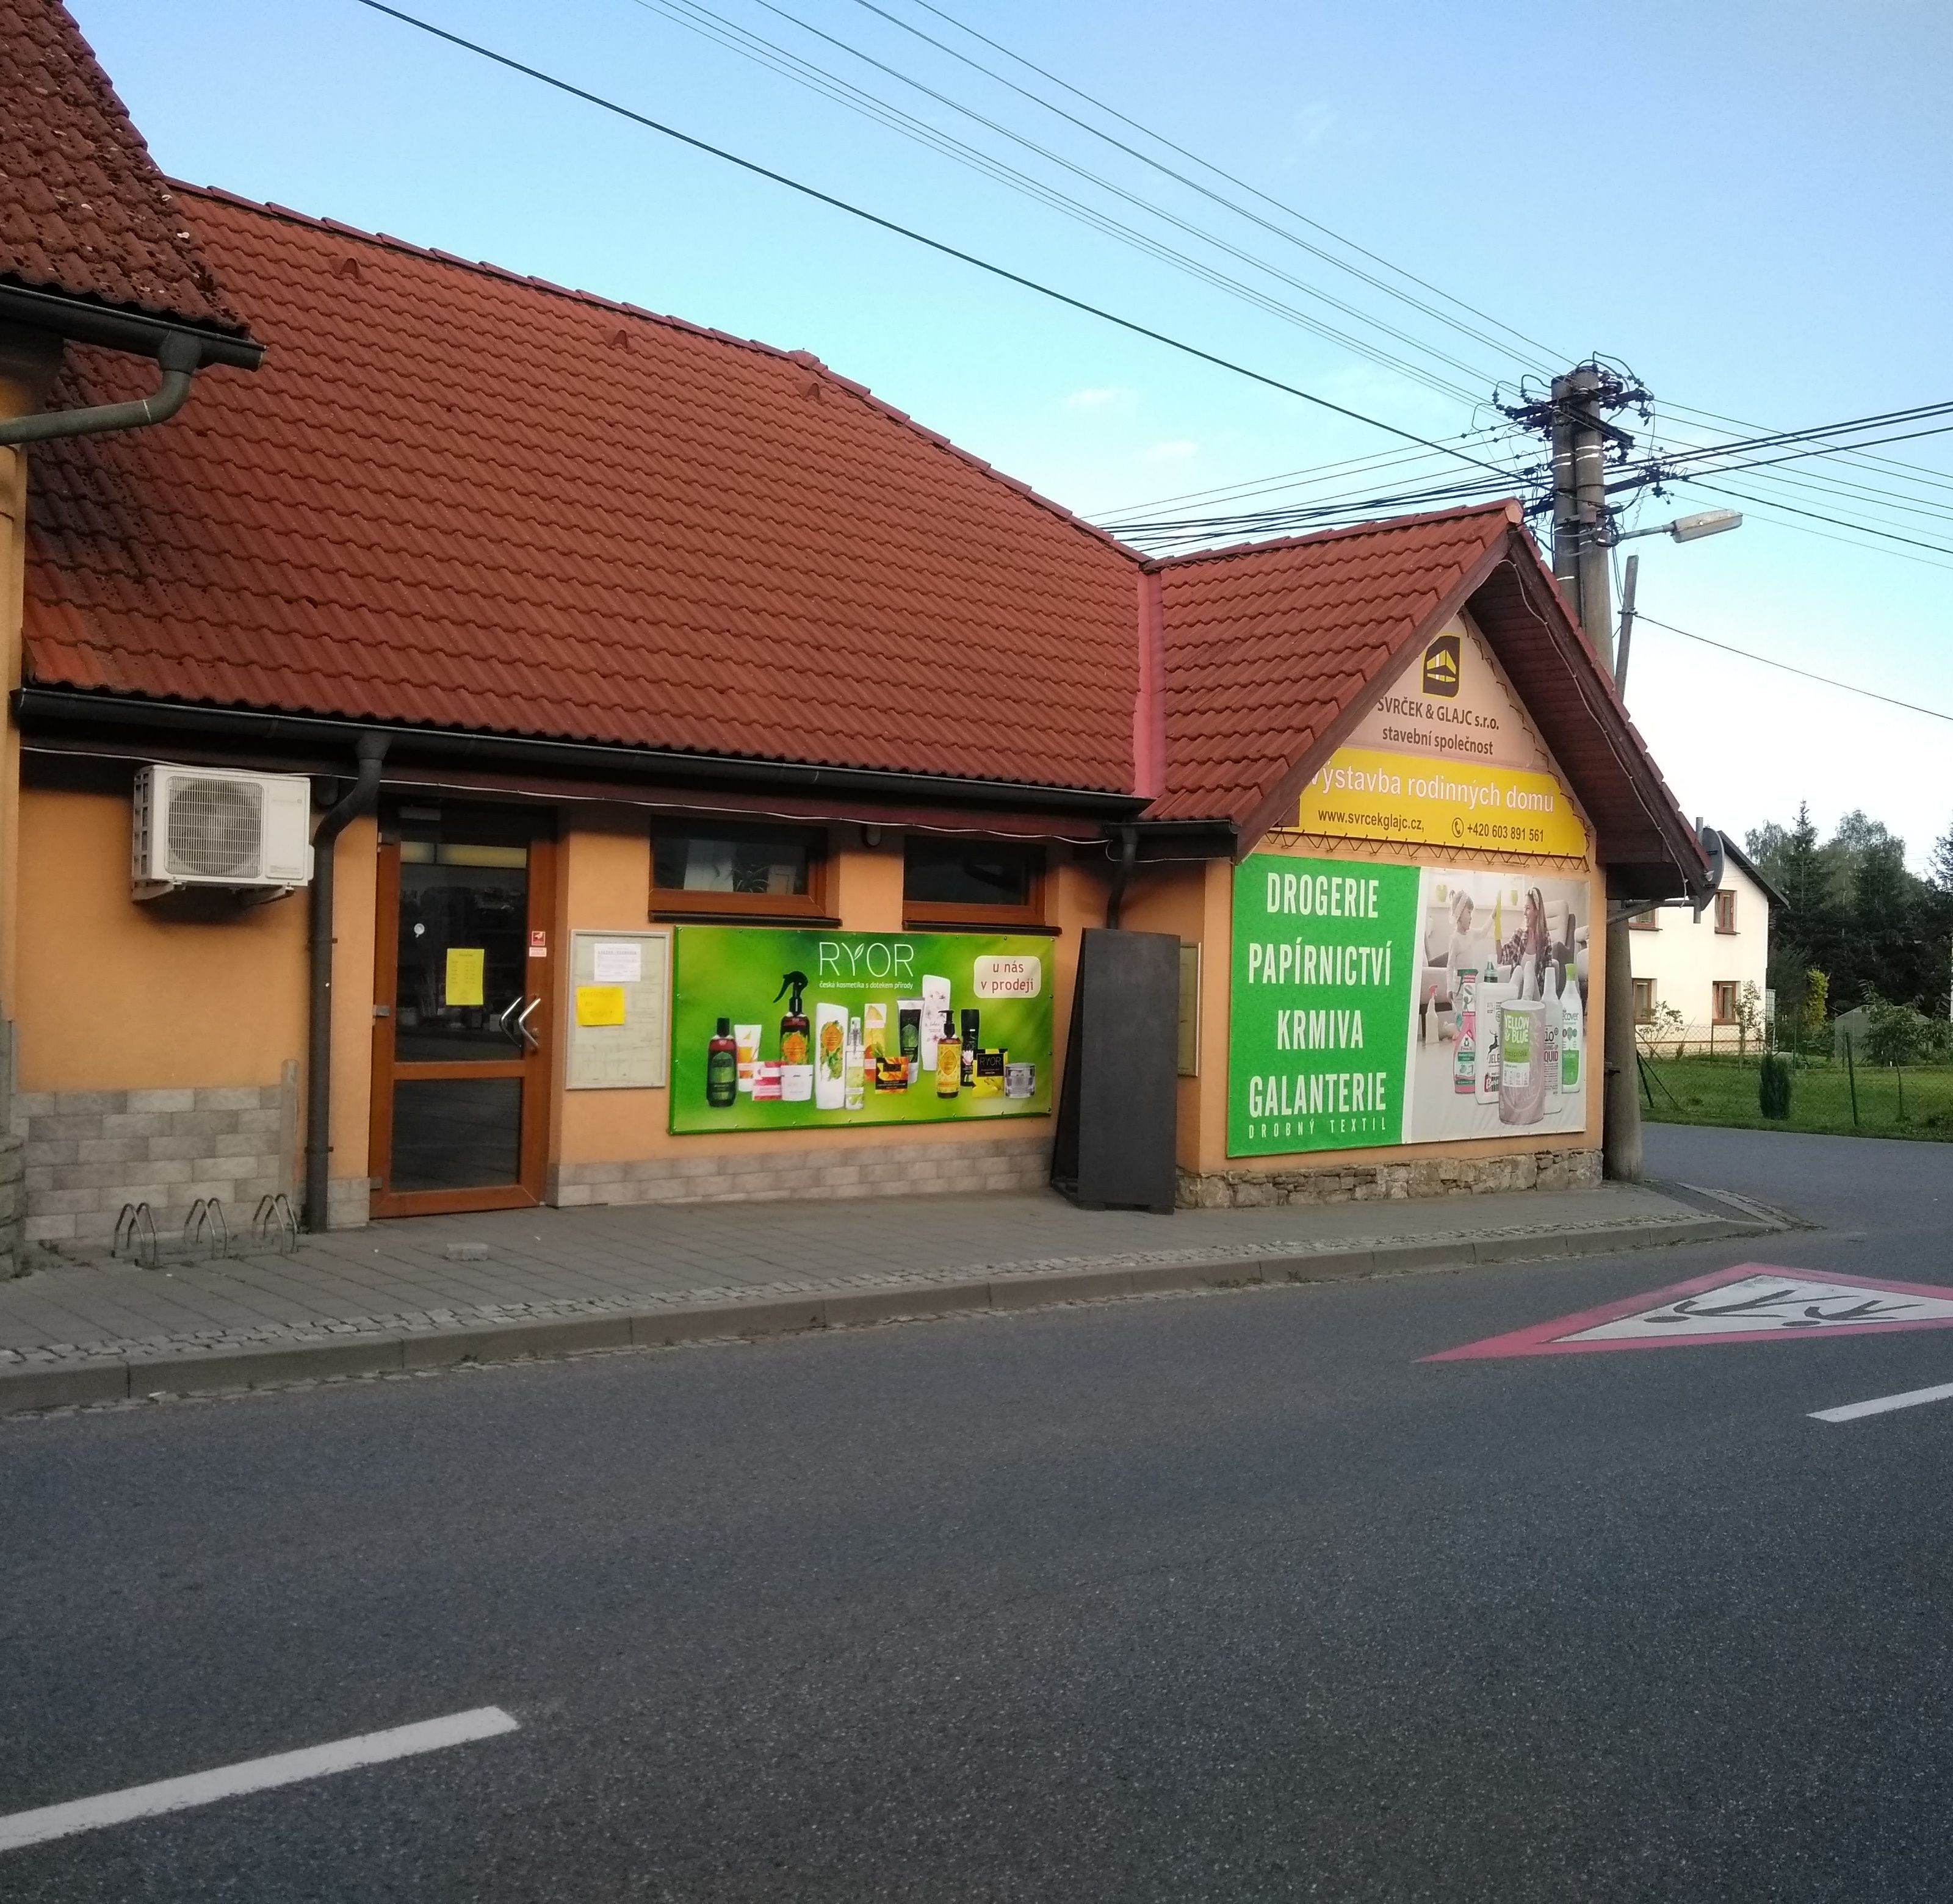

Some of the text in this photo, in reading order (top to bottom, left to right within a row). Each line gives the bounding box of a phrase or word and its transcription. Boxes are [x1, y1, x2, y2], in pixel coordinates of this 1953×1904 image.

[1377, 696, 1500, 730] SVRČEK & GLAJC s.r.o.
[1382, 726, 1493, 755] stavební společnost
[1408, 774, 1500, 810] rodinných
[1506, 785, 1554, 812] domu
[1467, 823, 1489, 837] +420
[1492, 824, 1508, 839] 603
[1511, 827, 1526, 840] 891
[1529, 829, 1544, 842] 561
[1267, 872, 1379, 918] DROGERIE
[819, 942, 914, 978] RYOR
[992, 960, 1024, 973] u nás
[1249, 937, 1392, 986] PAPÍRNICTVÍ
[894, 981, 914, 990] přírody
[981, 978, 1034, 994] v prodeji
[1277, 1010, 1363, 1050] KRMIVA
[1504, 1015, 1529, 1030] YELLOW
[1504, 1029, 1529, 1044] & BLUE
[980, 1056, 1002, 1066] RYOR
[1249, 1072, 1387, 1118] GALANTERIE
[1249, 1117, 1385, 1139] DROBNÝ TEXTIL
